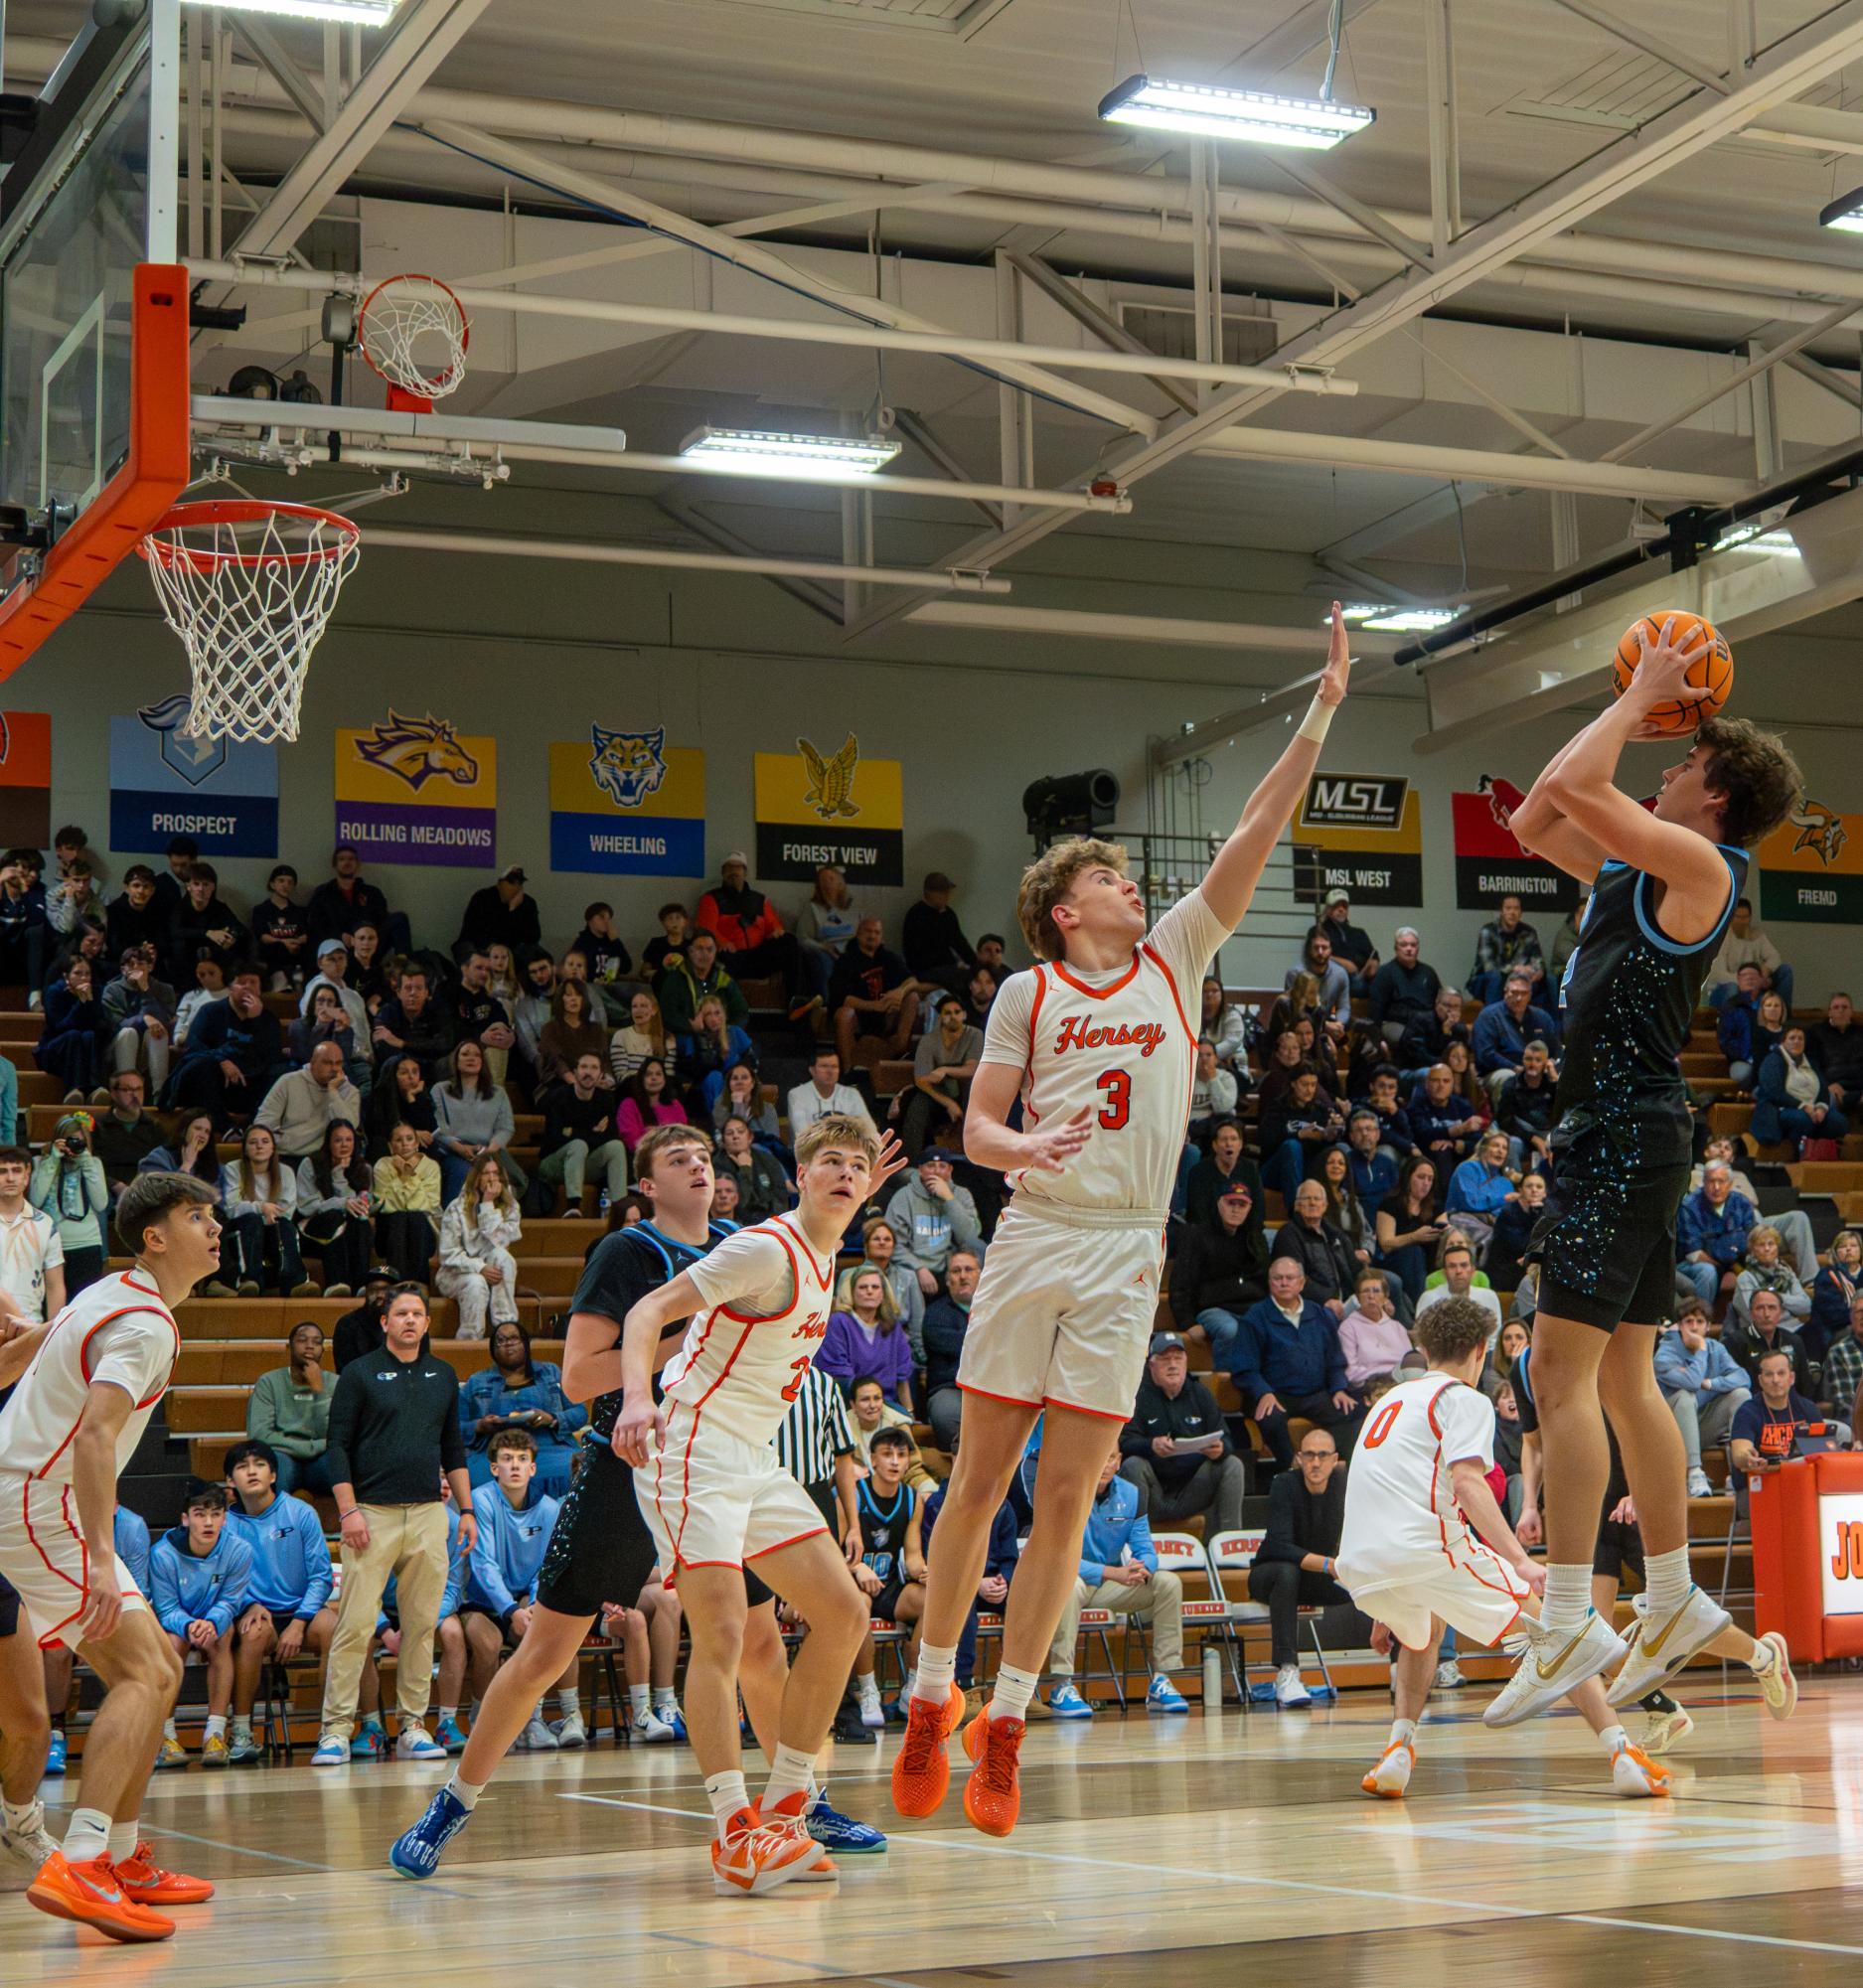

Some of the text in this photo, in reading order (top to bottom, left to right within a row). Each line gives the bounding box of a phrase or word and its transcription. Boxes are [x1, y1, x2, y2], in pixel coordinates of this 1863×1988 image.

[1314, 780, 1395, 813] MSL
[152, 814, 236, 835] PROSPECT
[340, 822, 492, 847] ROLLING MEADOWS
[589, 835, 667, 855] WHEELING
[783, 843, 877, 864] FOREST VIEW
[1325, 868, 1392, 887] MSL WEST
[1478, 875, 1558, 894] BARRINGTON
[1797, 889, 1837, 906] FREMD
[1054, 1014, 1166, 1057] Hersey
[1097, 1069, 1131, 1130] 3
[1363, 1400, 1403, 1450] 0
